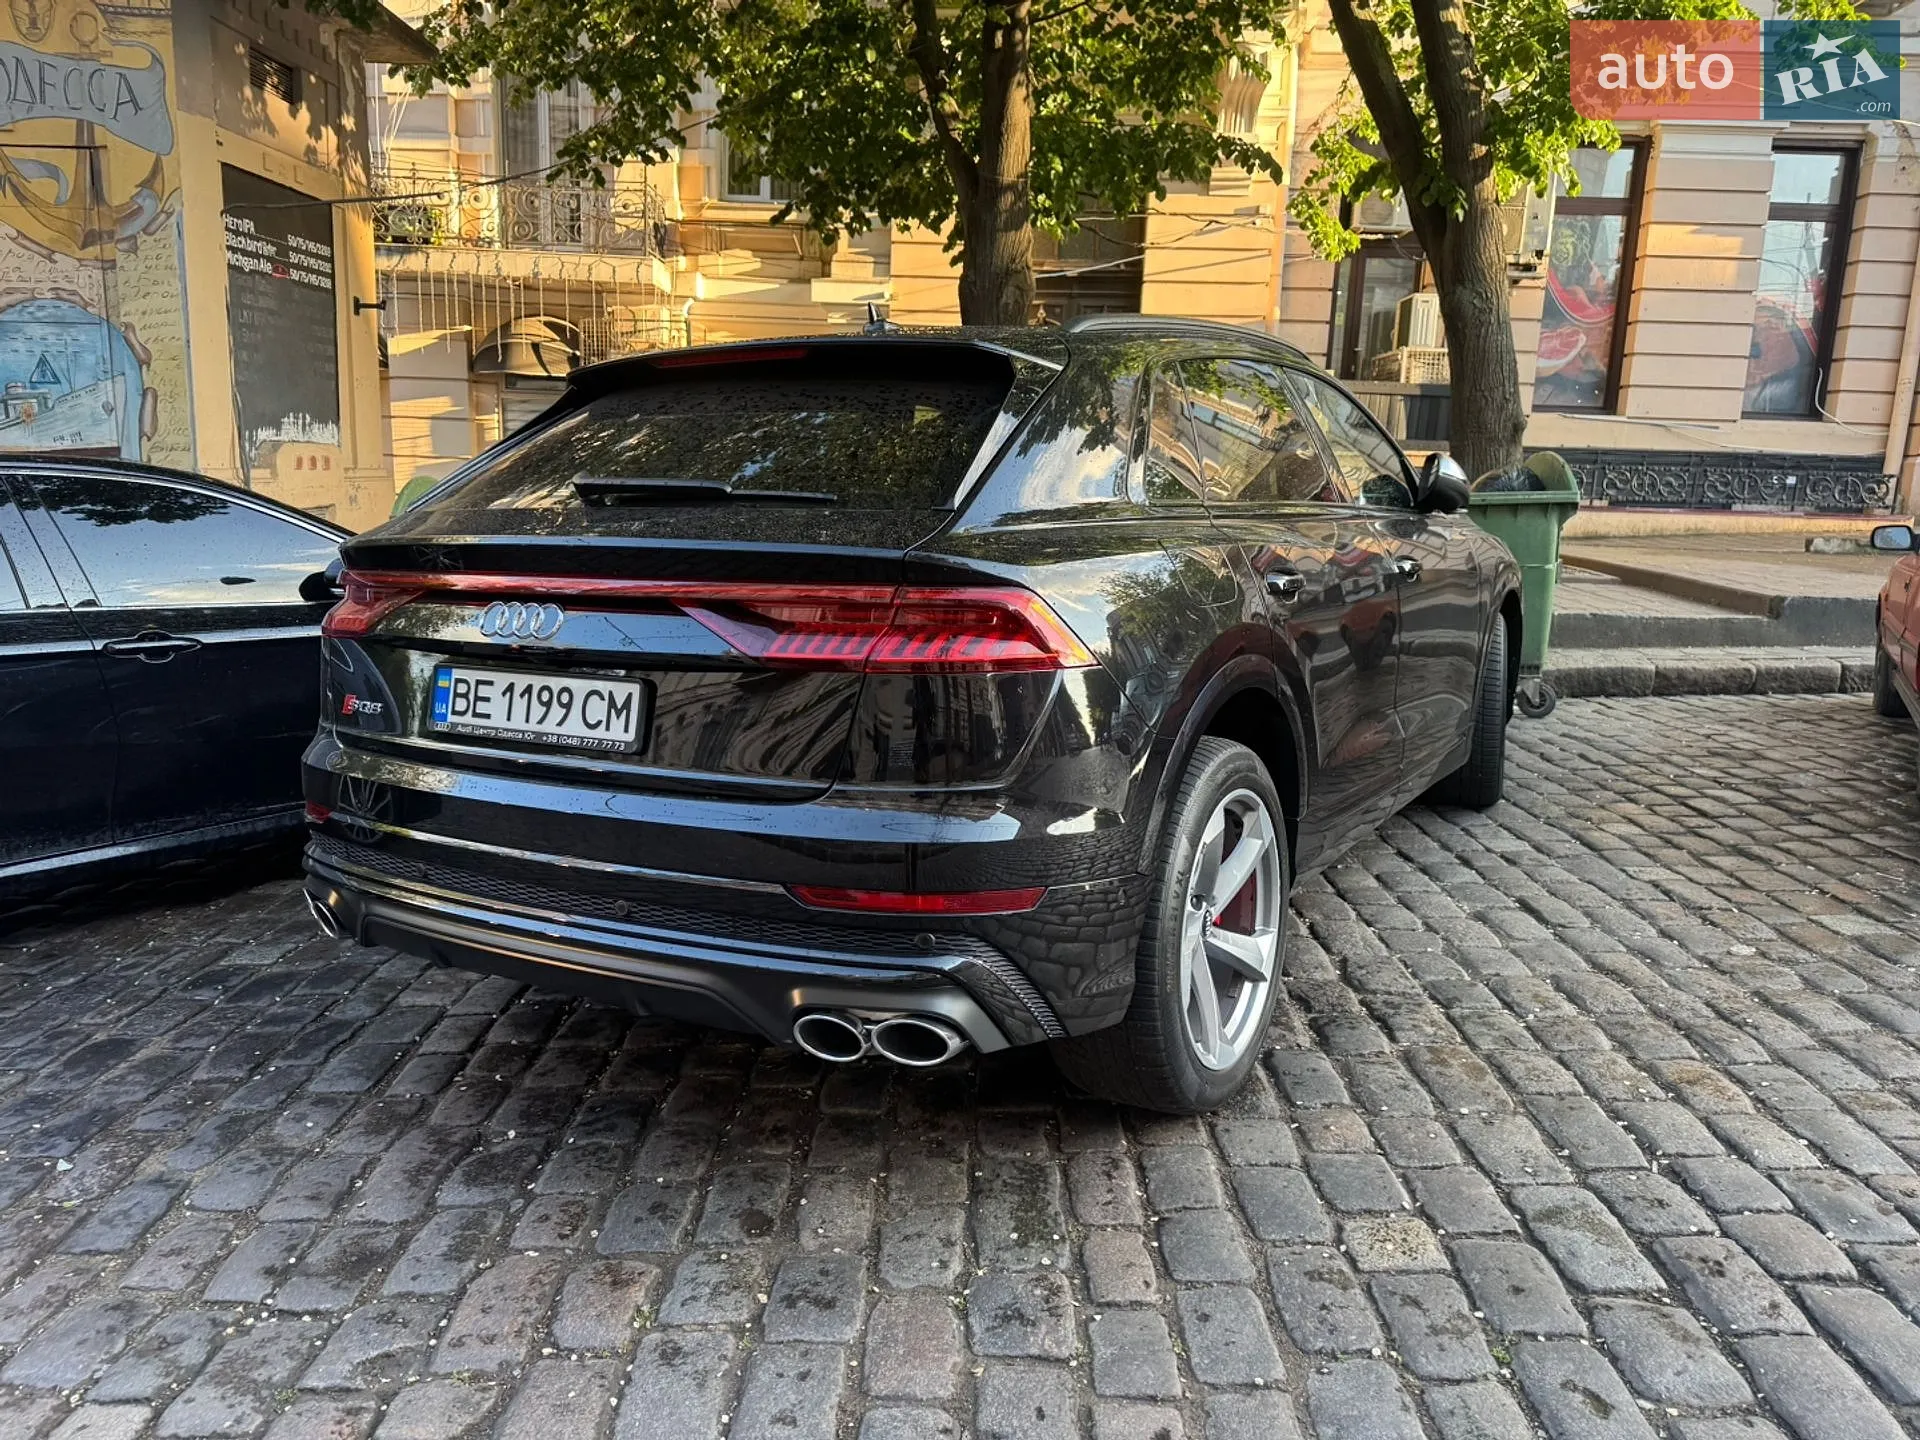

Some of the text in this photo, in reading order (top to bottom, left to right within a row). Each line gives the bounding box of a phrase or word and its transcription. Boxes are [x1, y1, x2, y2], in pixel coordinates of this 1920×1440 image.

[259, 257, 272, 274] Ale
[435, 702, 447, 714] UA
[451, 677, 633, 734] BE 1199 CM
[456, 724, 472, 734] Audi
[542, 734, 559, 743] +38
[582, 738, 599, 748] 777
